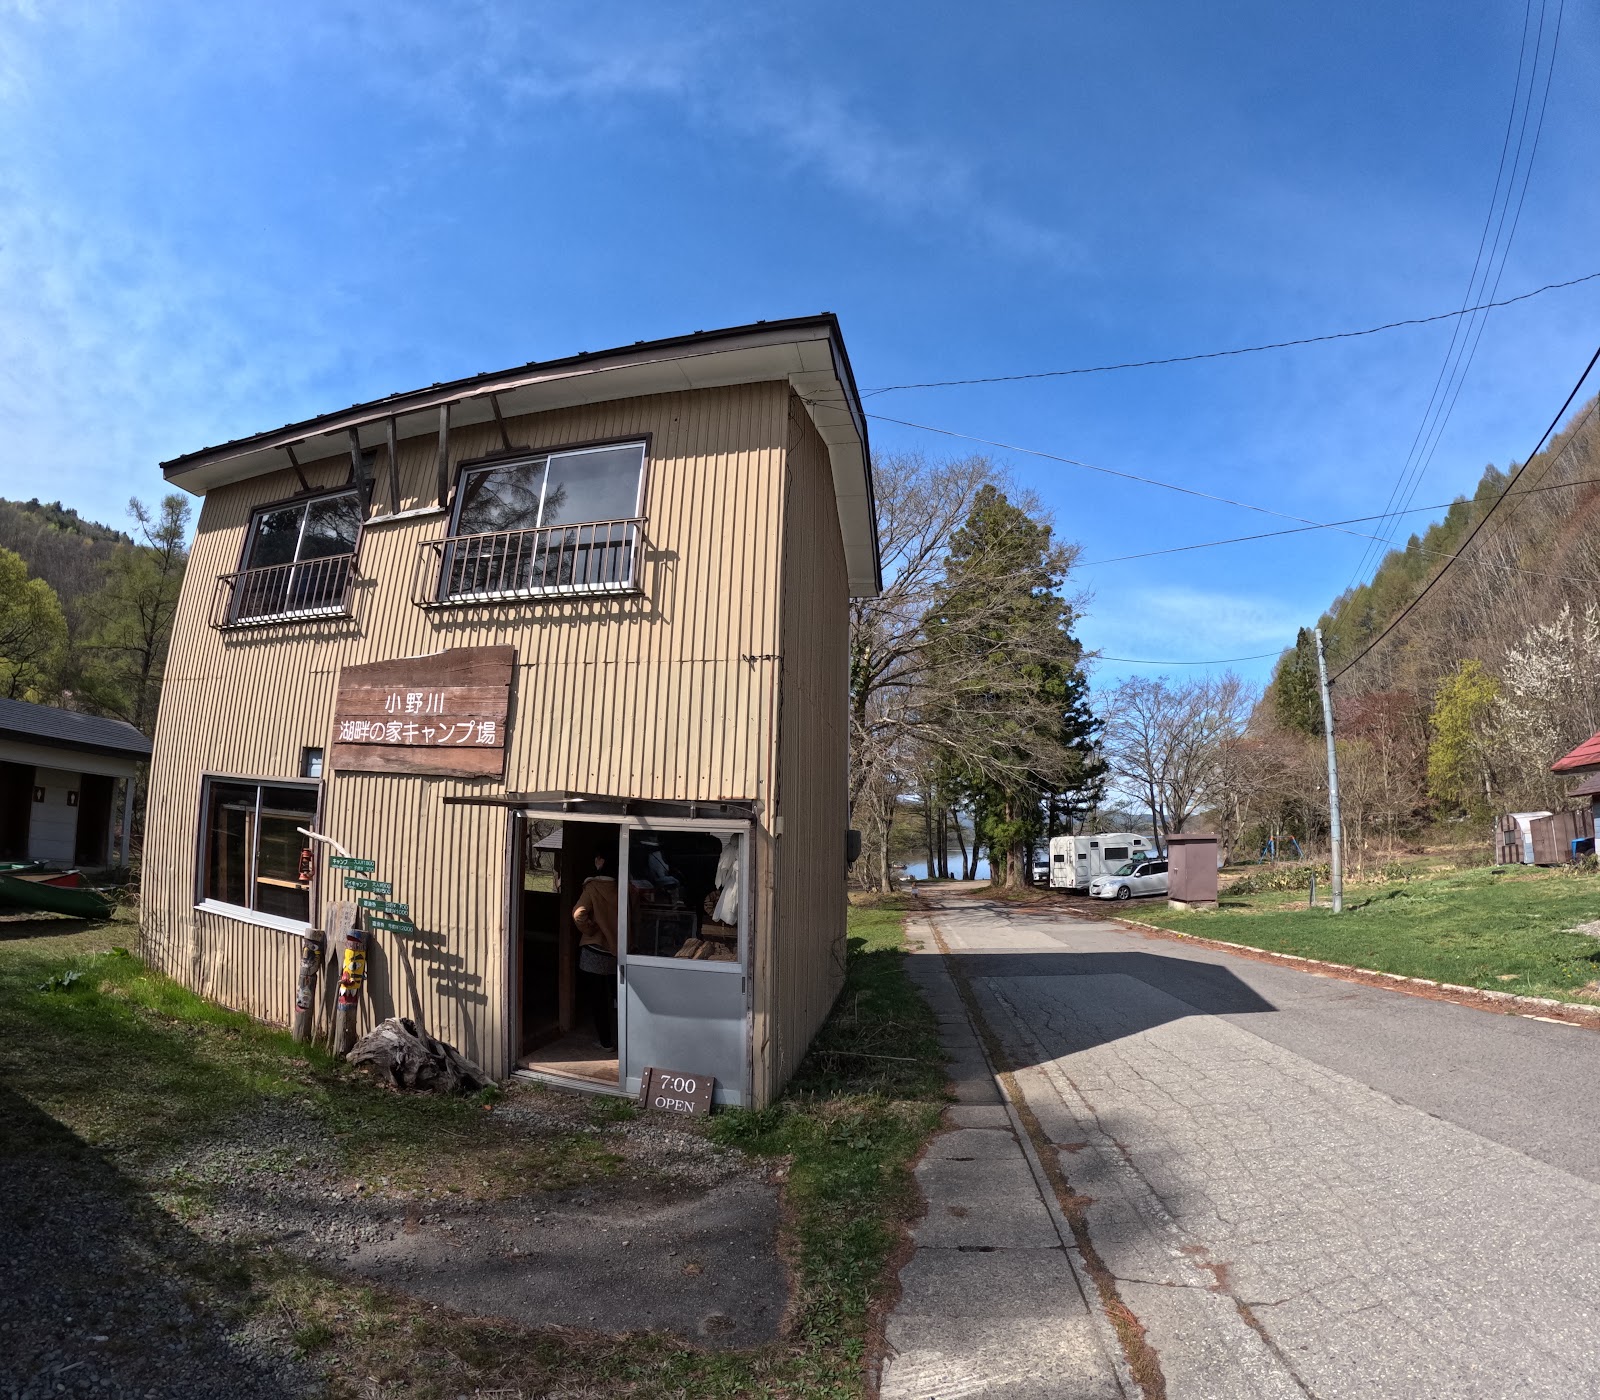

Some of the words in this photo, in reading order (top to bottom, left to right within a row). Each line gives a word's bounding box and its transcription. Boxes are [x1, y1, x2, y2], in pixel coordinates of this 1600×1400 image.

[385, 692, 445, 714] 小野川
[339, 720, 496, 745] 湖畔の家キャンプ場
[661, 1075, 696, 1094] 7:00
[655, 1096, 695, 1113] OPEN
